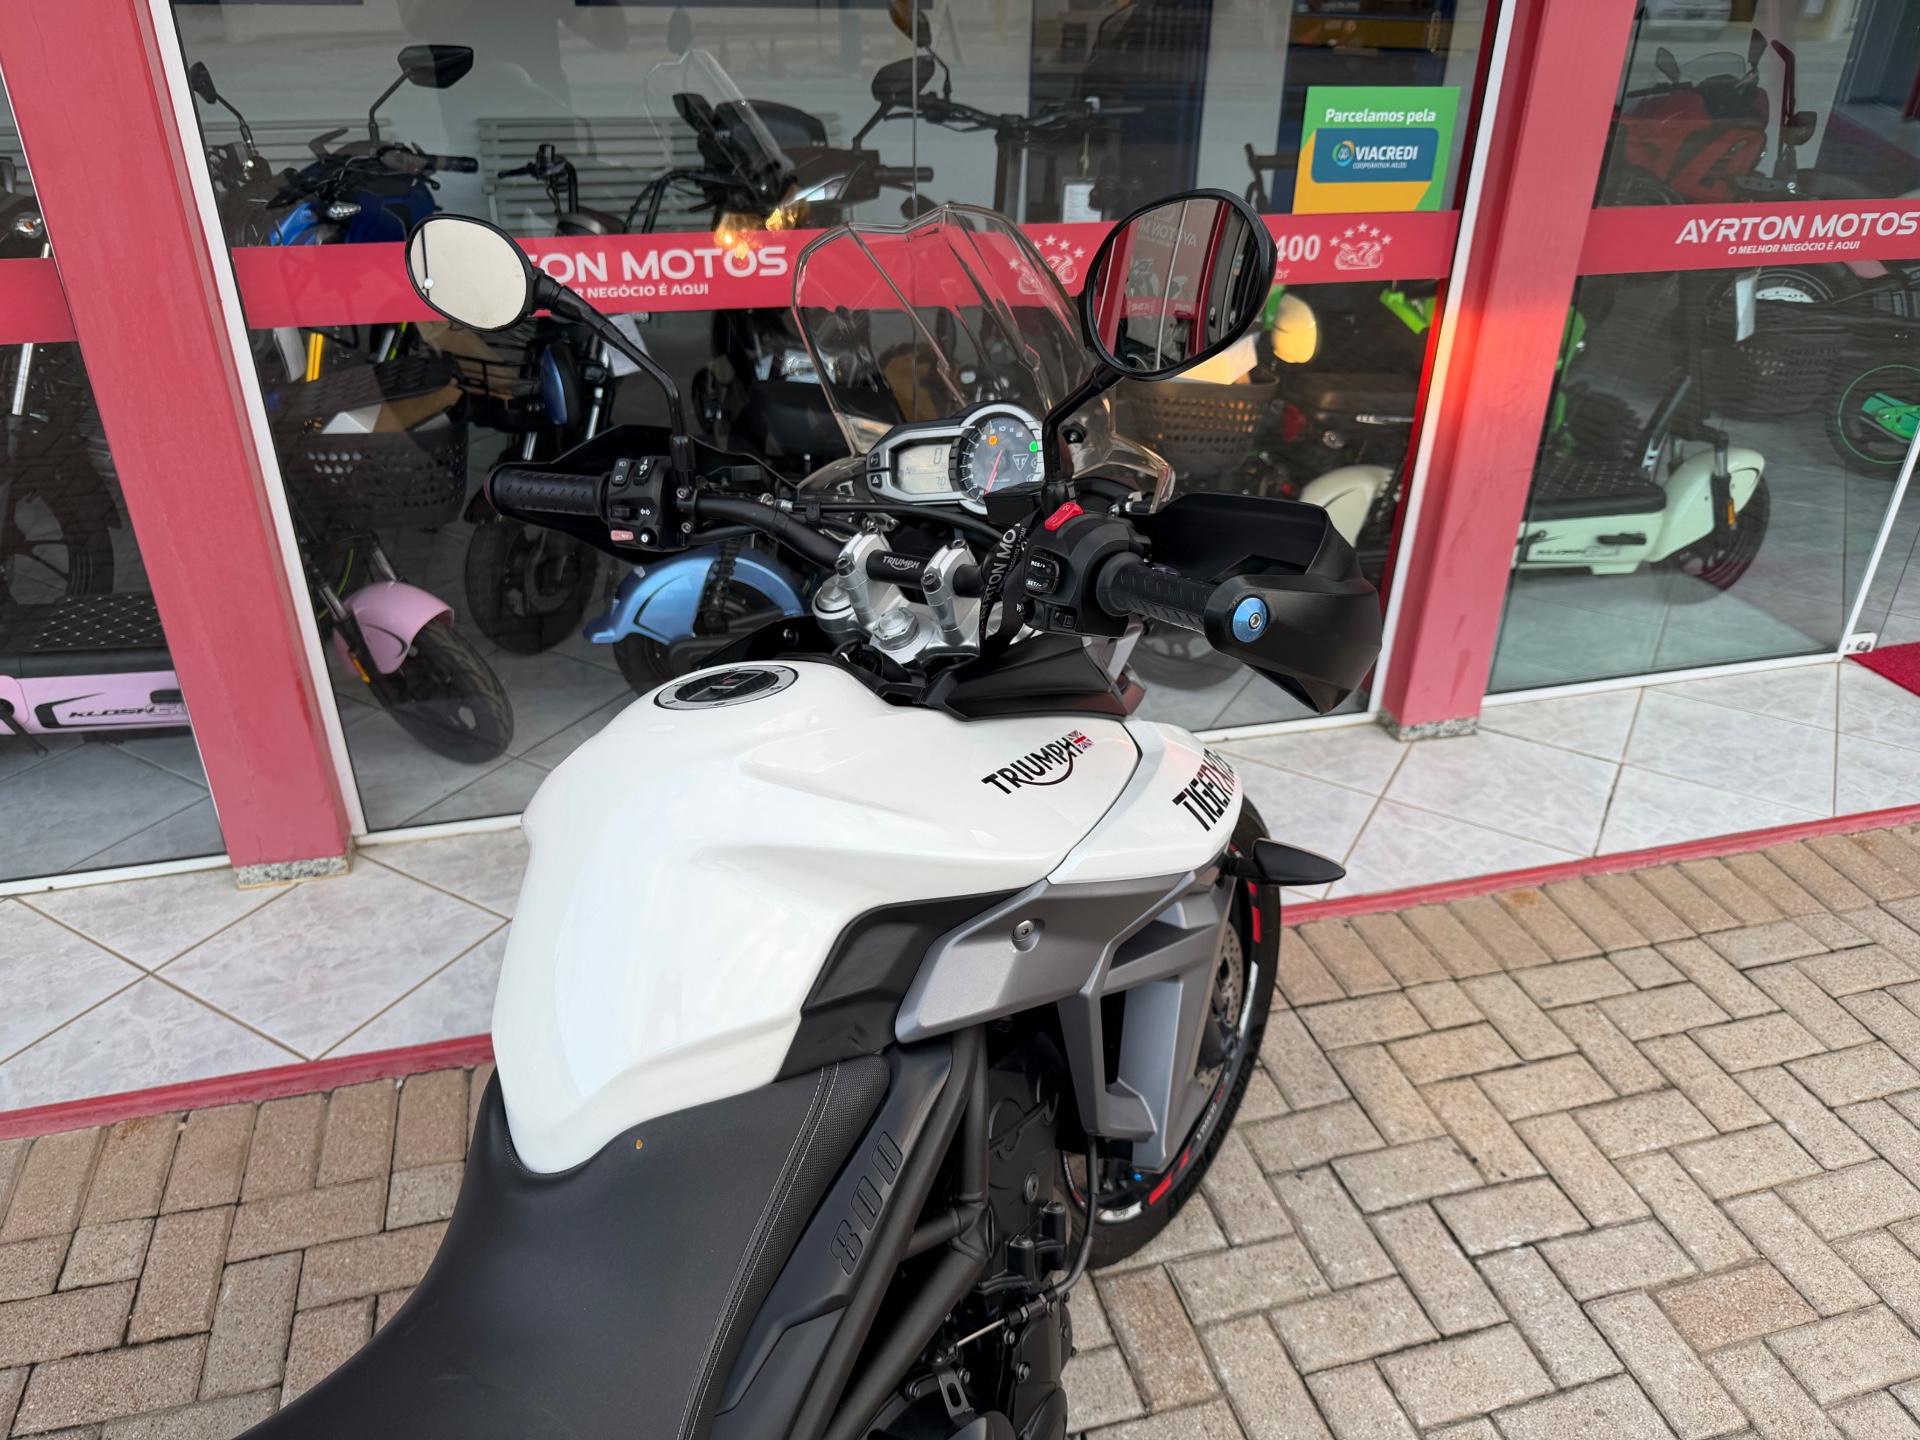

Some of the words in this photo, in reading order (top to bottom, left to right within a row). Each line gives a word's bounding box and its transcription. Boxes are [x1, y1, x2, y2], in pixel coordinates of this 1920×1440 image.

[1325, 108, 1403, 123] Parcelamos
[1406, 108, 1436, 125] pela
[1355, 146, 1418, 161] VIACREDI
[1675, 214, 1805, 244] AYRTON
[1809, 211, 1920, 239] MOTOS
[1727, 246, 1736, 254] O
[1737, 243, 1779, 254] MELHOR
[1780, 241, 1825, 253] NEGÓCIO
[1827, 239, 1834, 250] É
[1835, 240, 1861, 250] AQUI
[621, 246, 788, 281] MOTOS
[587, 284, 656, 298] NEGÓCIO
[659, 284, 668, 296] É
[671, 283, 709, 296] AQUI
[882, 556, 920, 570] TRIUMPH
[981, 737, 1084, 794] TRIUMPH
[830, 1131, 903, 1276] 800
